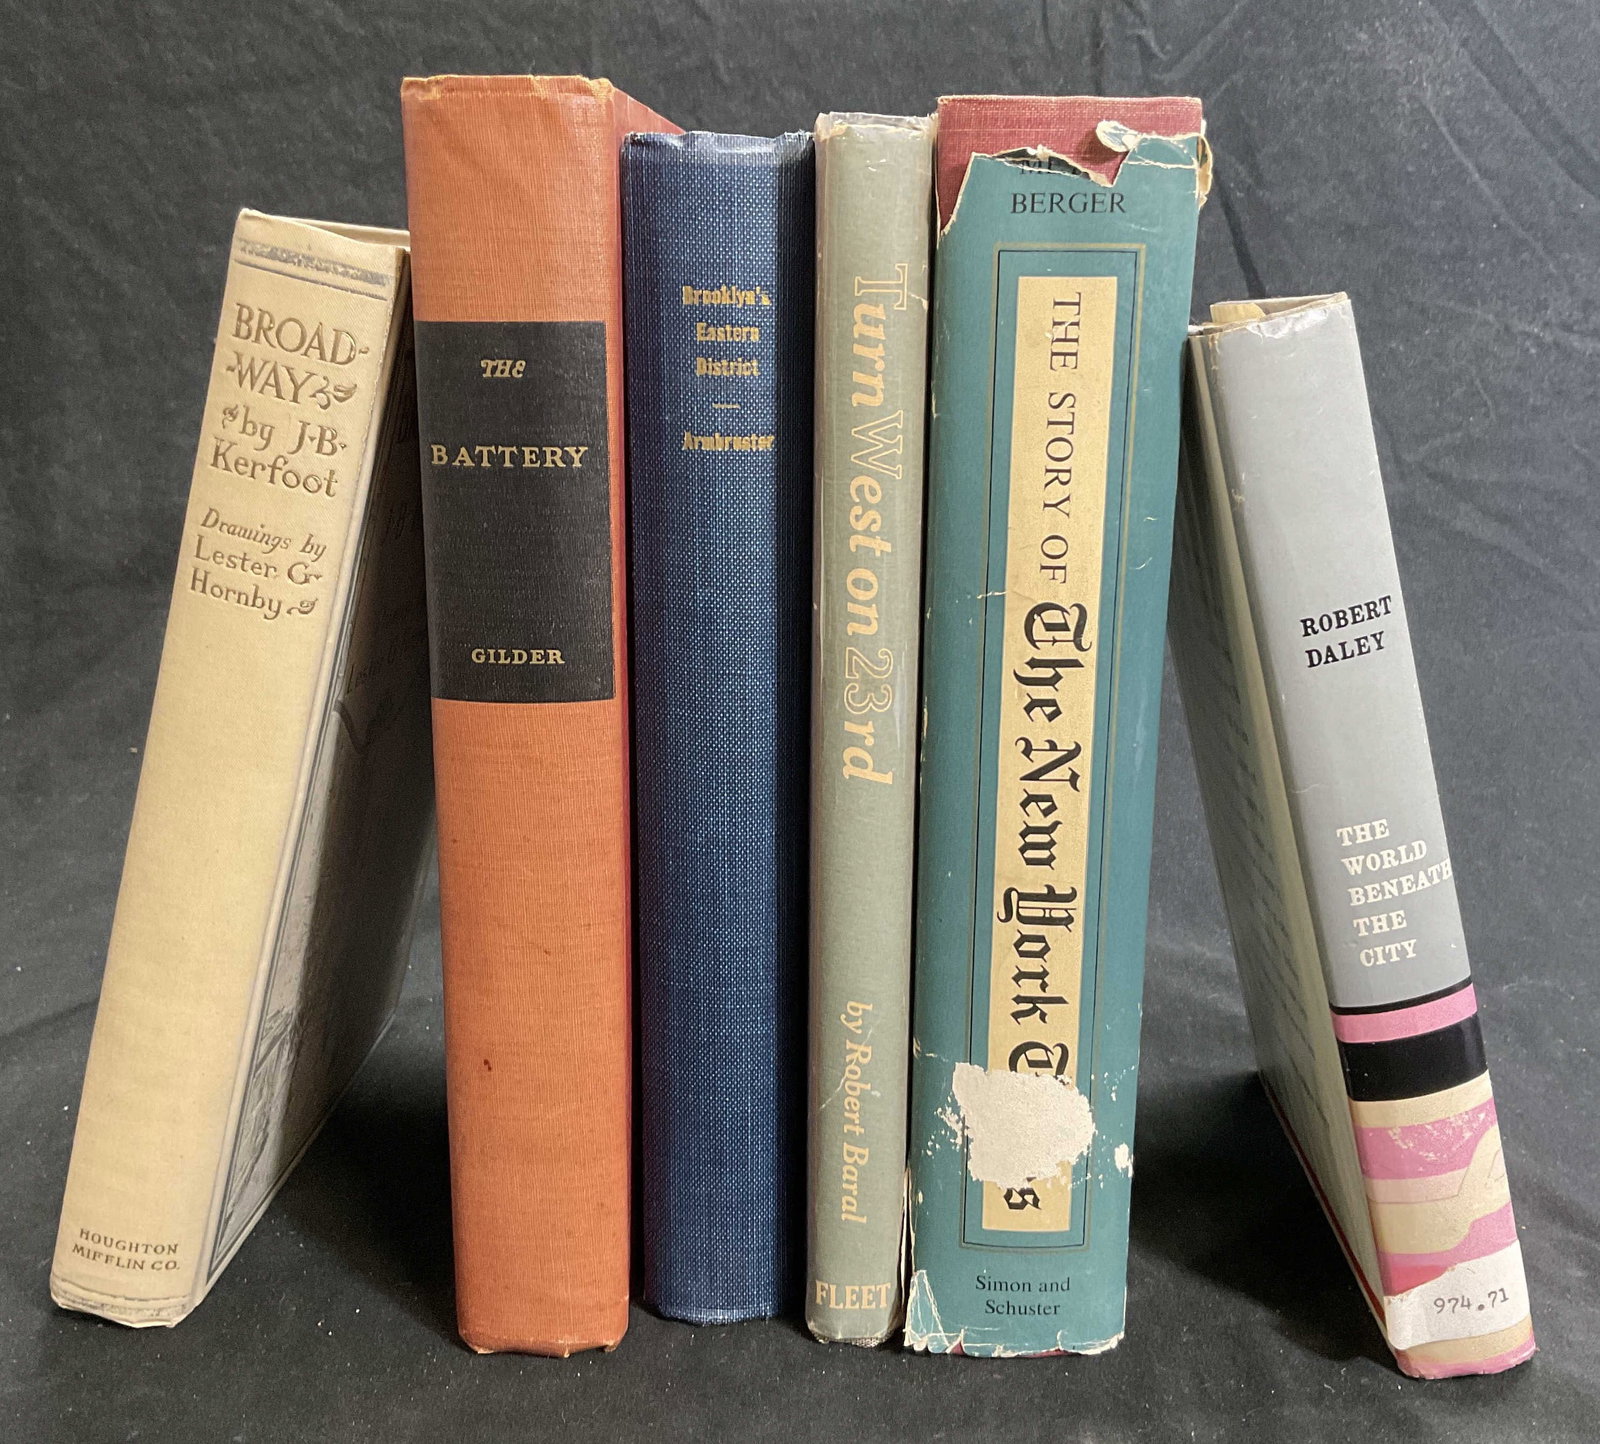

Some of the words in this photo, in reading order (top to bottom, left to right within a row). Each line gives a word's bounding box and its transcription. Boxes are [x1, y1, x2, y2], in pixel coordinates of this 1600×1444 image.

[1011, 191, 1126, 214] BERGER
[682, 284, 772, 308] Brooklyn's
[696, 322, 760, 342] Eastern
[850, 263, 908, 407] Turn
[1049, 291, 1082, 371] THE
[695, 357, 761, 377] District
[239, 405, 275, 451] by
[682, 431, 775, 451] Armbruster
[211, 436, 338, 497] Kerfoot
[431, 444, 588, 468] BATTERY
[1042, 391, 1077, 519] STORY
[850, 410, 904, 557] West
[200, 507, 292, 554] Drawings
[299, 533, 327, 562] by
[194, 534, 278, 578] Lester
[1039, 534, 1068, 584] OF
[190, 566, 283, 620] Hornby
[846, 567, 879, 636] on
[1300, 595, 1392, 637] ROBERT
[471, 649, 565, 665] GILDER
[1013, 602, 1093, 724] The
[1305, 630, 1385, 668] DALEY
[842, 646, 895, 785] 23rd
[1013, 736, 1082, 871] New
[1336, 818, 1390, 847] THE
[1341, 839, 1427, 876] WORLD
[1353, 910, 1407, 936] THE
[997, 884, 1078, 1026] York
[1359, 939, 1417, 967] CITY
[840, 1000, 873, 1035] by
[843, 1039, 873, 1136] Robert
[841, 1141, 870, 1224] Baral
[72, 1243, 145, 1270] MIFFLIN
[79, 1228, 179, 1255] HOUGHTON
[815, 1279, 891, 1310] FLEET
[975, 1275, 1032, 1293] Simon
[1038, 1276, 1070, 1292] and
[1433, 1287, 1510, 1314] 974.71
[984, 1299, 1061, 1316] Schuster
